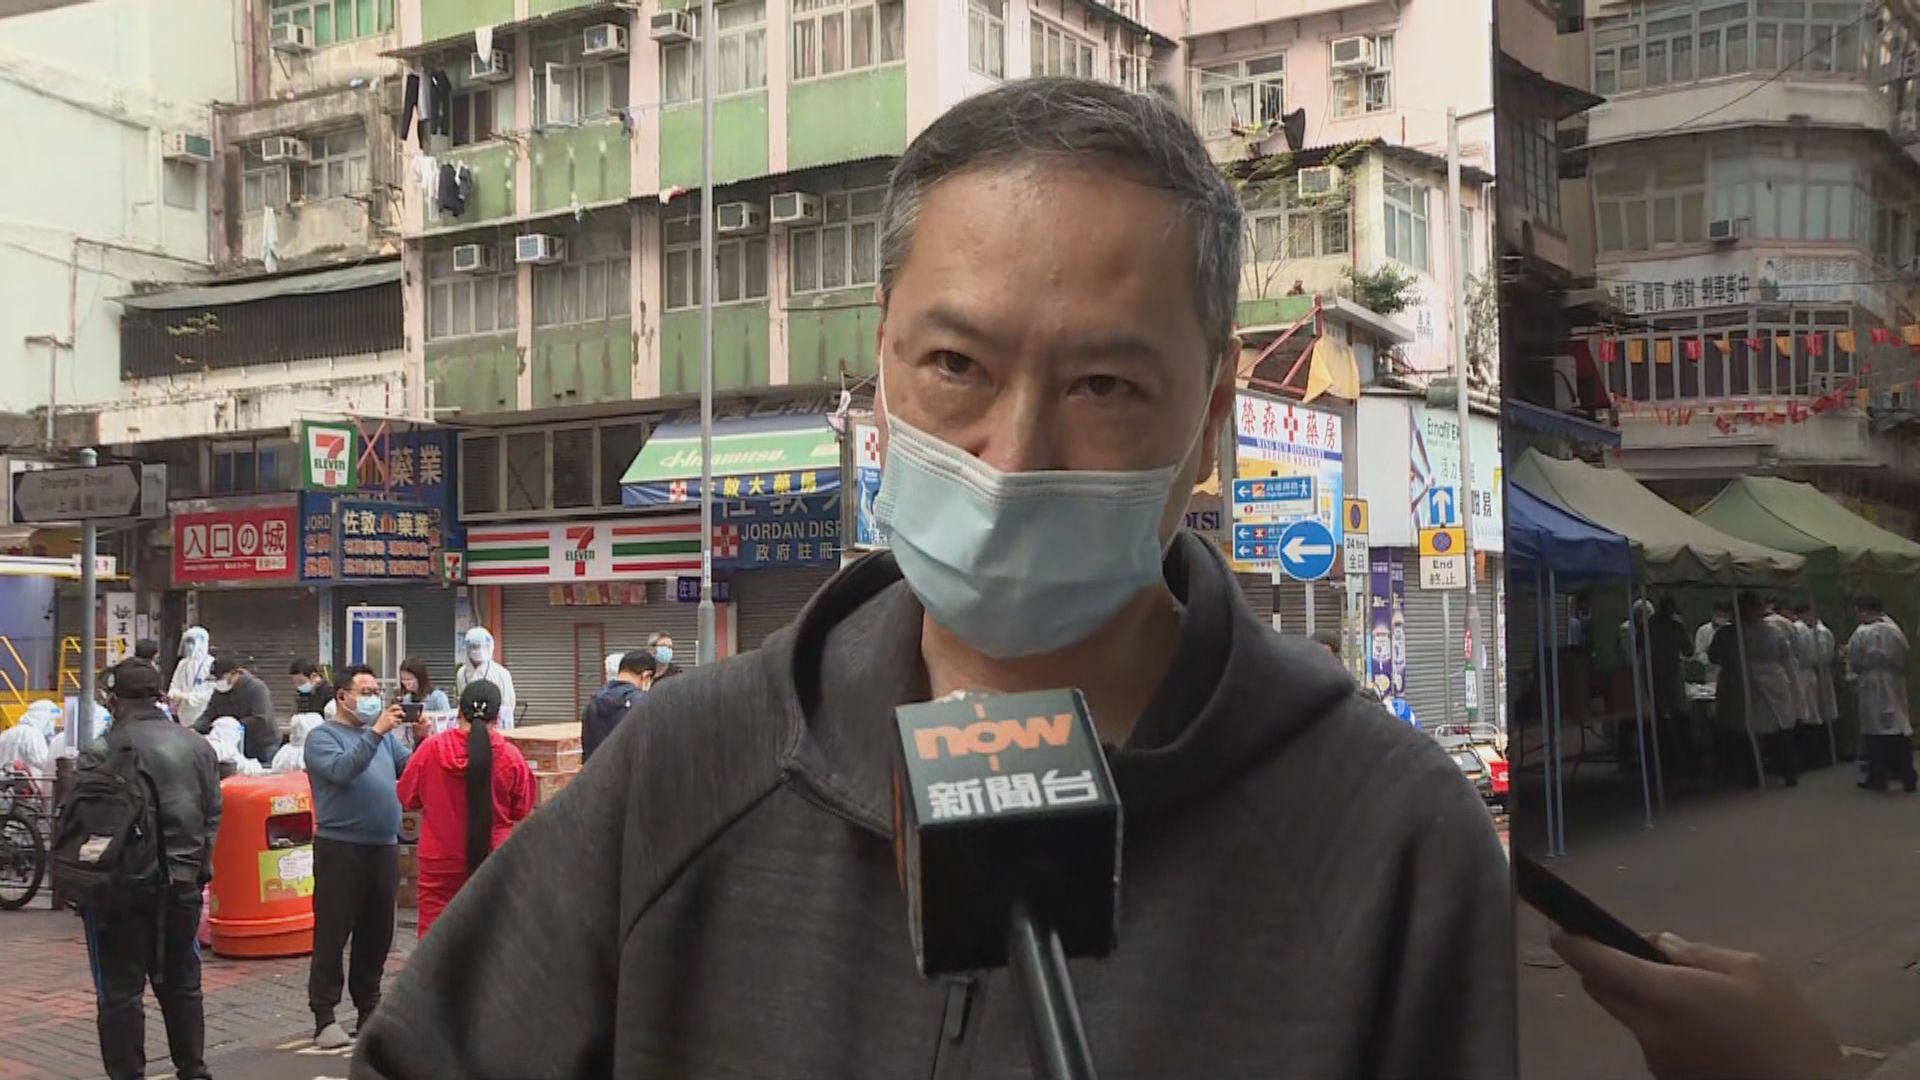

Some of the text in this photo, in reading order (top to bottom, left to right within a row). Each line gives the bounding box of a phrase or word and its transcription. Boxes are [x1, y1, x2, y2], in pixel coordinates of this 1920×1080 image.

[316, 434, 345, 487] 7
[700, 471, 817, 497] 敦大藥房
[741, 521, 805, 540] JORDAN
[566, 526, 595, 577] 7
[755, 541, 833, 561] 政府註冊
[1346, 538, 1355, 550] 24
[1349, 553, 1365, 569] 全日
[1433, 559, 1453, 570] End
[1429, 572, 1457, 585] 終止
[913, 708, 1075, 766] now
[926, 768, 1100, 820] 新聞台
